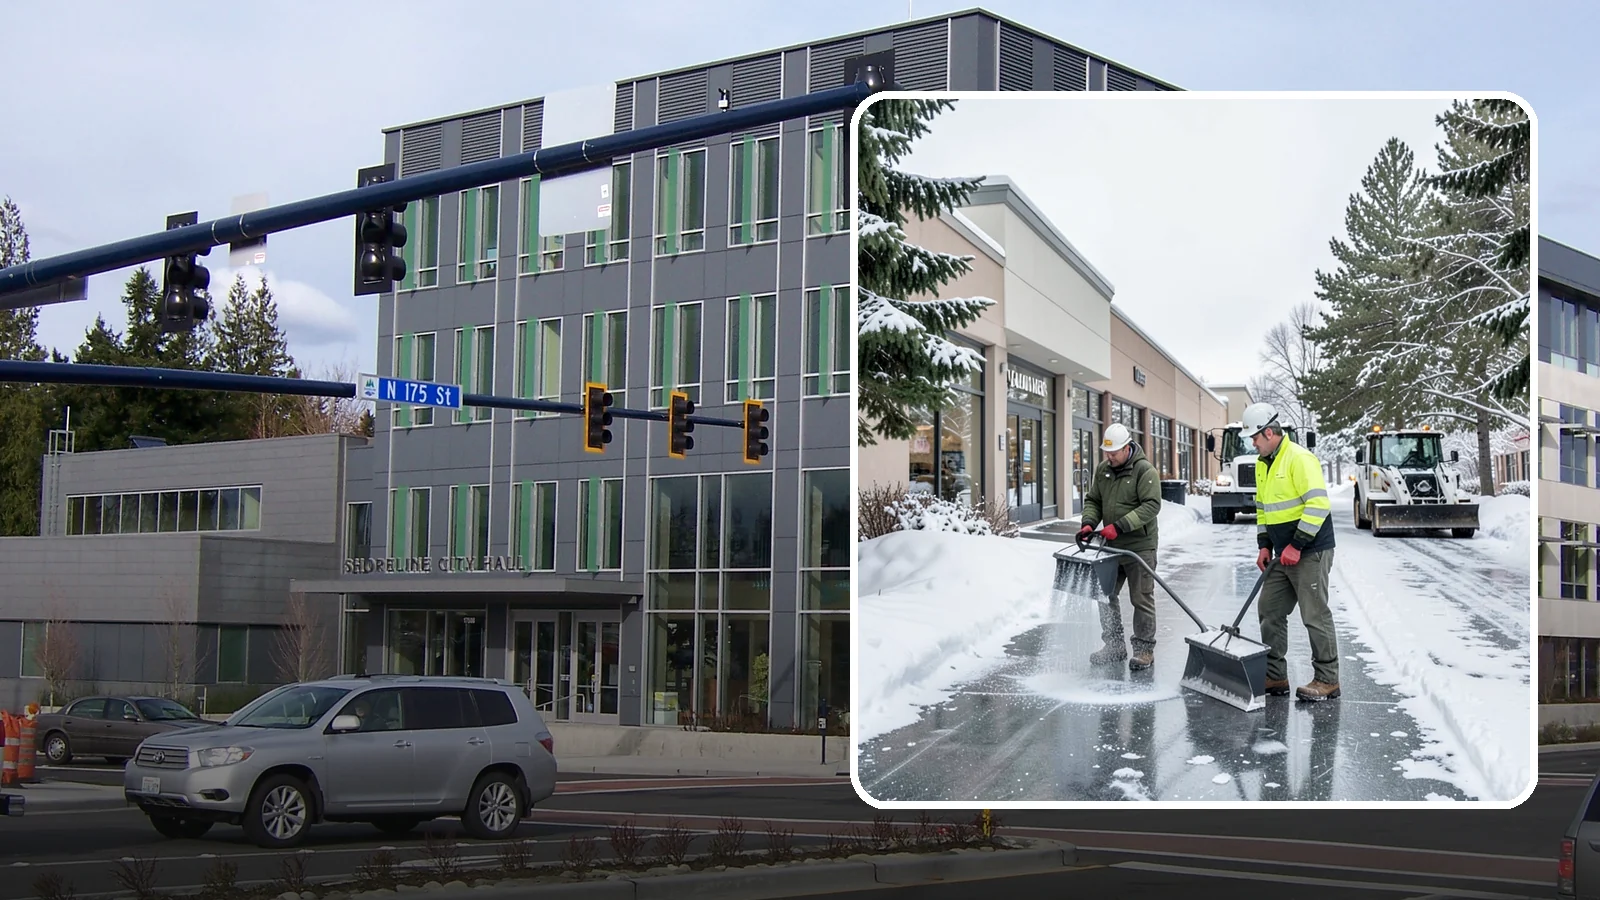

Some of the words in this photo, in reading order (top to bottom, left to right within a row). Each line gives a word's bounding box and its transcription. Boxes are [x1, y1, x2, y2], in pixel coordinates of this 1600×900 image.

[387, 380, 396, 400] N
[405, 383, 427, 403] 175
[436, 386, 451, 406] St
[344, 556, 432, 574] SHORELINE
[438, 556, 476, 572] CITY
[483, 555, 525, 572] HALL
